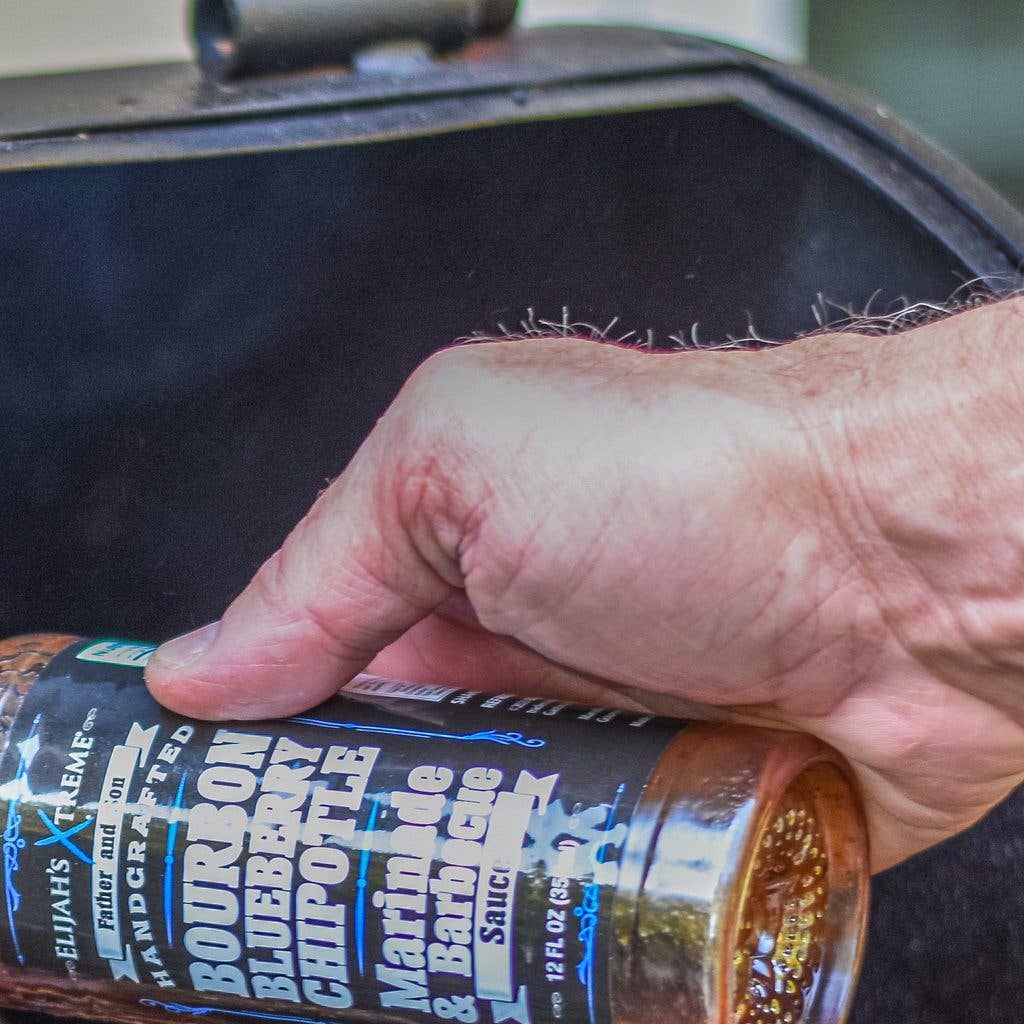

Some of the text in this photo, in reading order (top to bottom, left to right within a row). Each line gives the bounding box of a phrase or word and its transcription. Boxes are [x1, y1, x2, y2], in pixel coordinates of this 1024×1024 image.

[45, 857, 79, 961] ELIJAH'S
[97, 776, 126, 931] Father and on
[125, 724, 195, 989] HANDCRAFTED
[182, 728, 273, 998] BOURBON
[244, 736, 323, 1003] BLUEBERRY
[295, 745, 381, 1009] CHIPOTLE
[544, 839, 581, 982] 12 FL OZ (35)
[432, 994, 479, 1024] &
